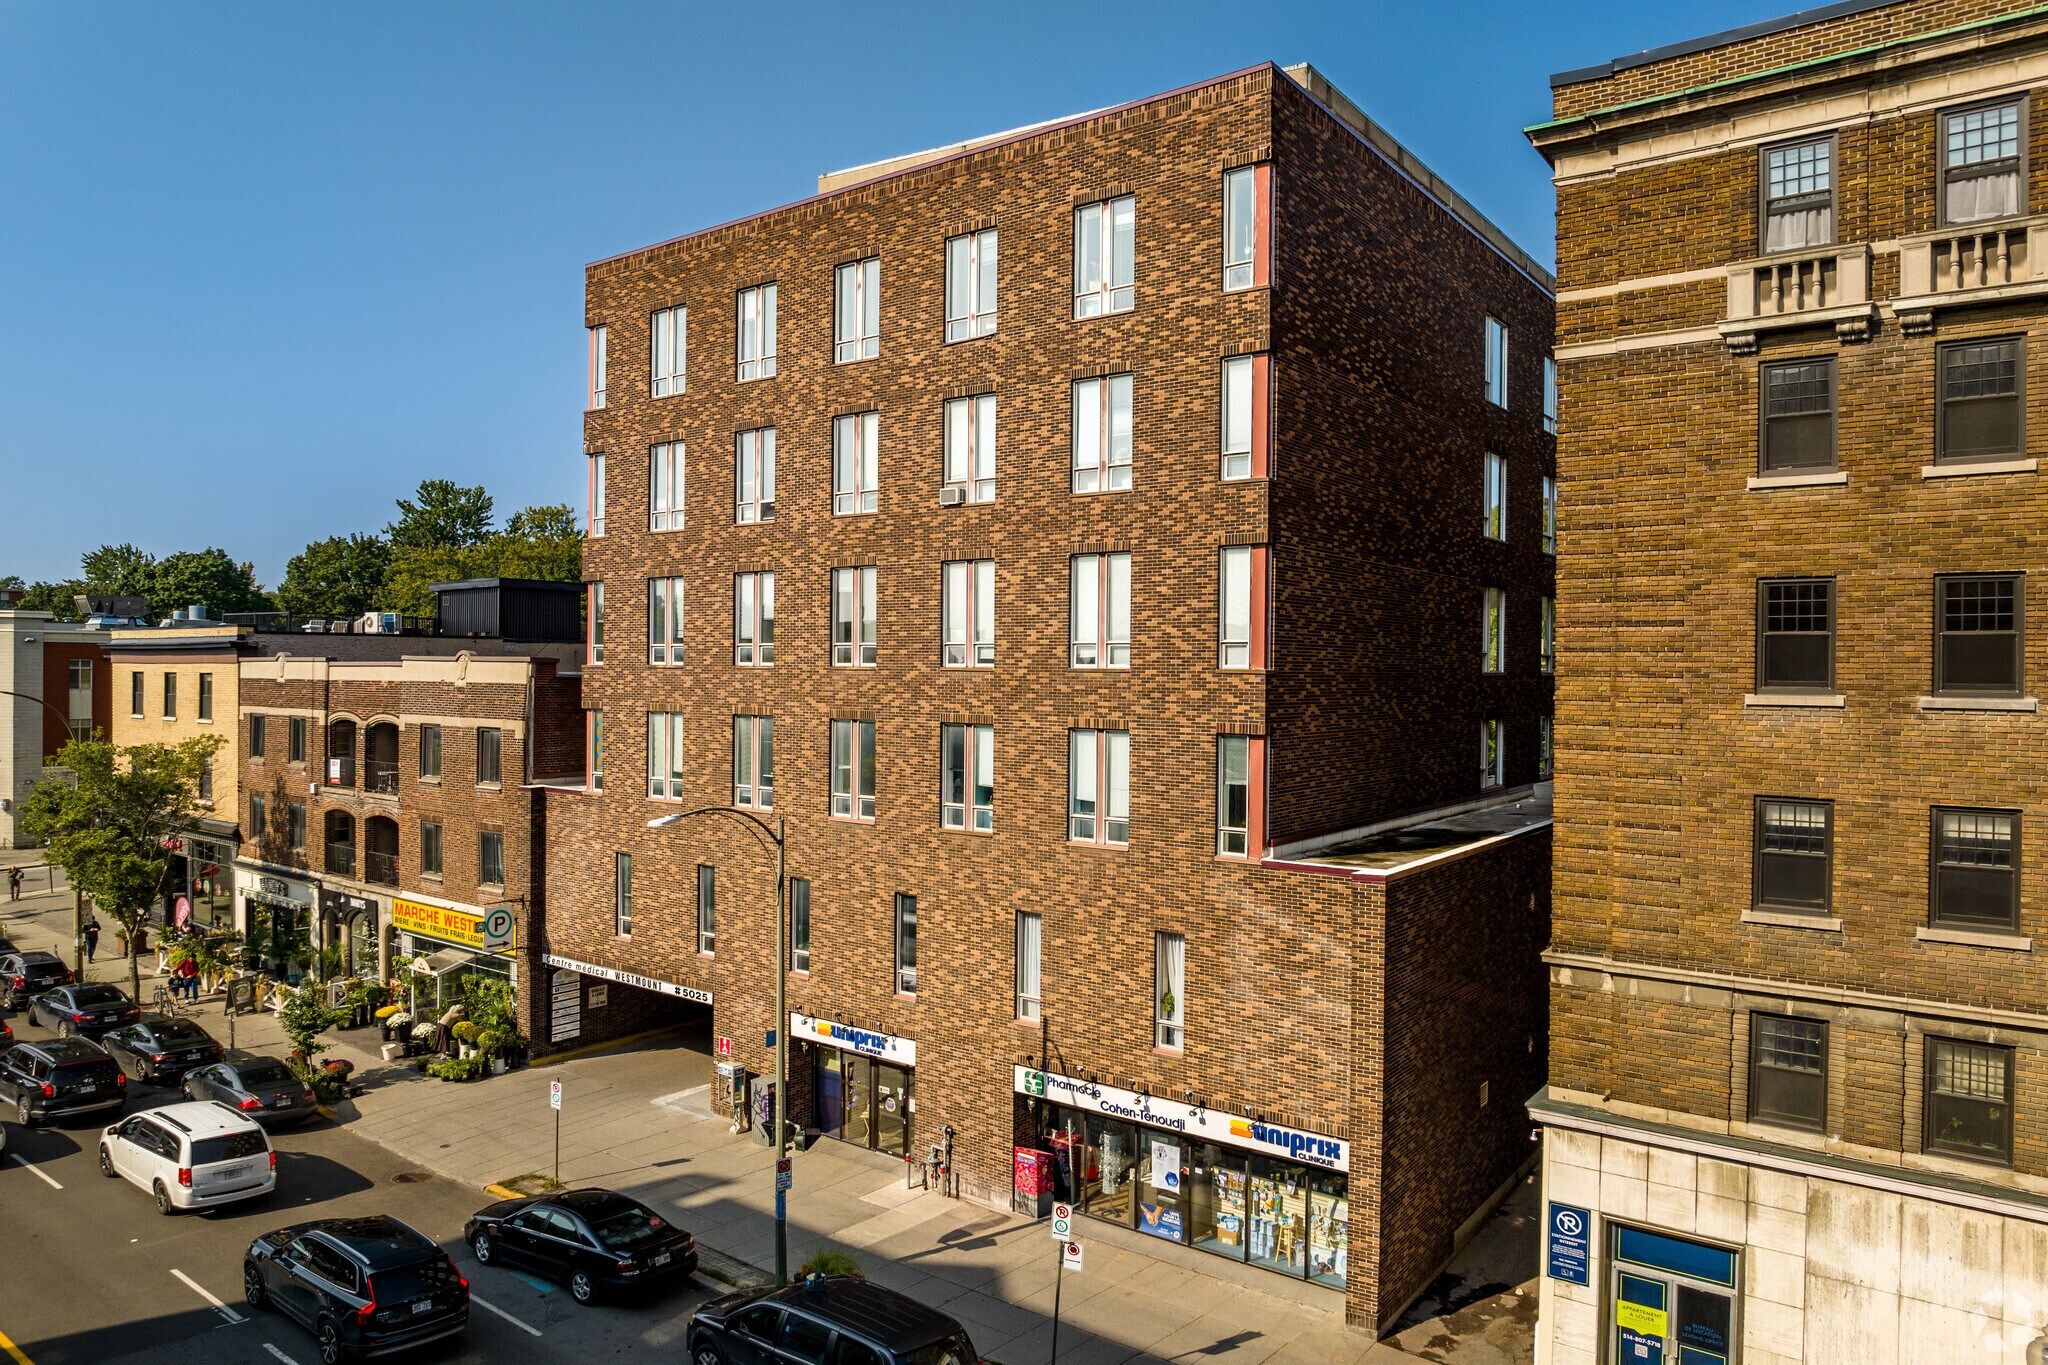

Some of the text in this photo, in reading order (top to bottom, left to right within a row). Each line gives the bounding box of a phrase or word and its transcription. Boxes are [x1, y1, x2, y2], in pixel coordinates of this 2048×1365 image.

[395, 903, 478, 933] MARCHE WEST
[495, 916, 505, 932] P
[413, 920, 426, 930] VINS
[430, 925, 448, 936] FRUITS
[450, 930, 466, 940] FRAIS
[546, 956, 572, 969] Centre
[576, 964, 608, 978] médical
[615, 972, 662, 991] WESTMOUNT
[675, 986, 708, 1002] #5025
[831, 1024, 886, 1050] uniprix
[1047, 1076, 1101, 1098] Pharmacie
[1253, 1124, 1341, 1160] uniprix
[1298, 1153, 1334, 1167] CLINIQUE
[1622, 1305, 1662, 1319] APPARTEMENT
[1635, 1314, 1655, 1322] LOUER
[1692, 1324, 1714, 1333] BUREAU
[1693, 1328, 1722, 1340] LOCATION
[1682, 1332, 1724, 1347] LEASING OFFICE
